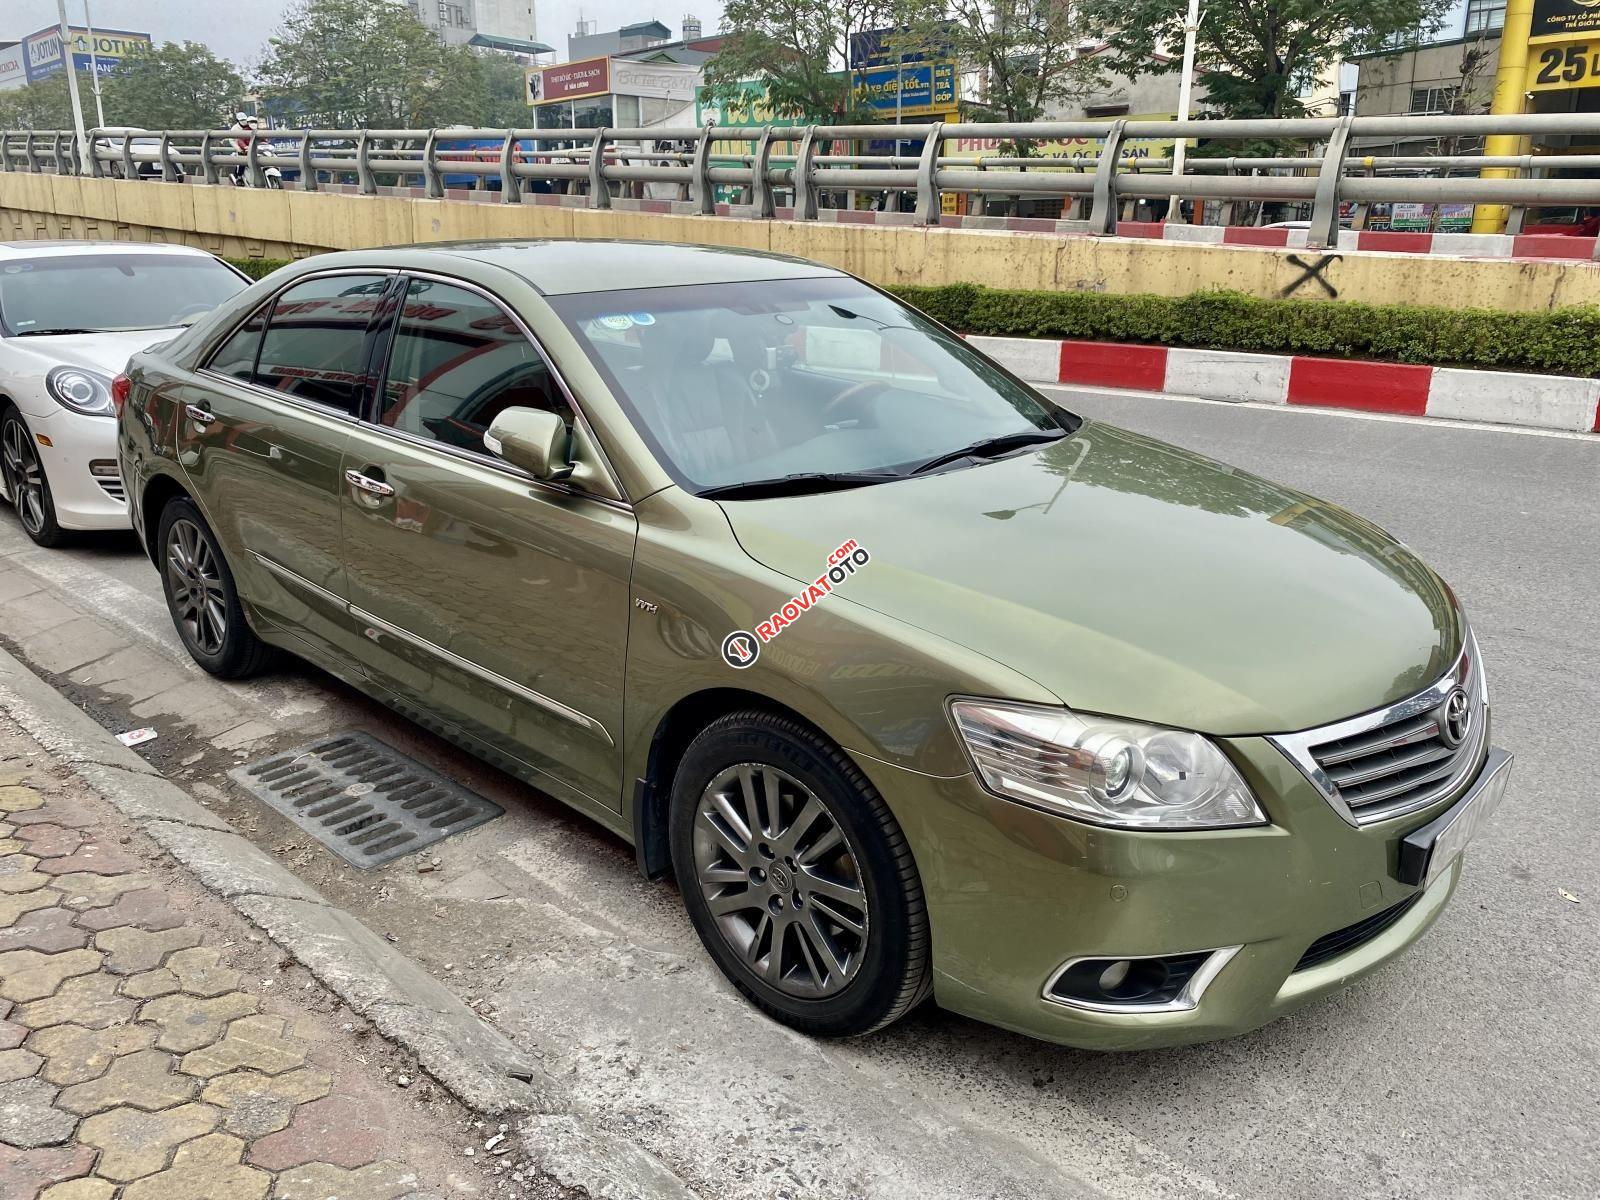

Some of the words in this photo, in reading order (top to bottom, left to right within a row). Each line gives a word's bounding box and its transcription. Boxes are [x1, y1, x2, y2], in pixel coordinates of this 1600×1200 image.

[36, 37, 60, 61] JOTUN
[1536, 46, 1589, 84] 25
[935, 90, 952, 101] GÓP
[1122, 145, 1150, 159] SẢN
